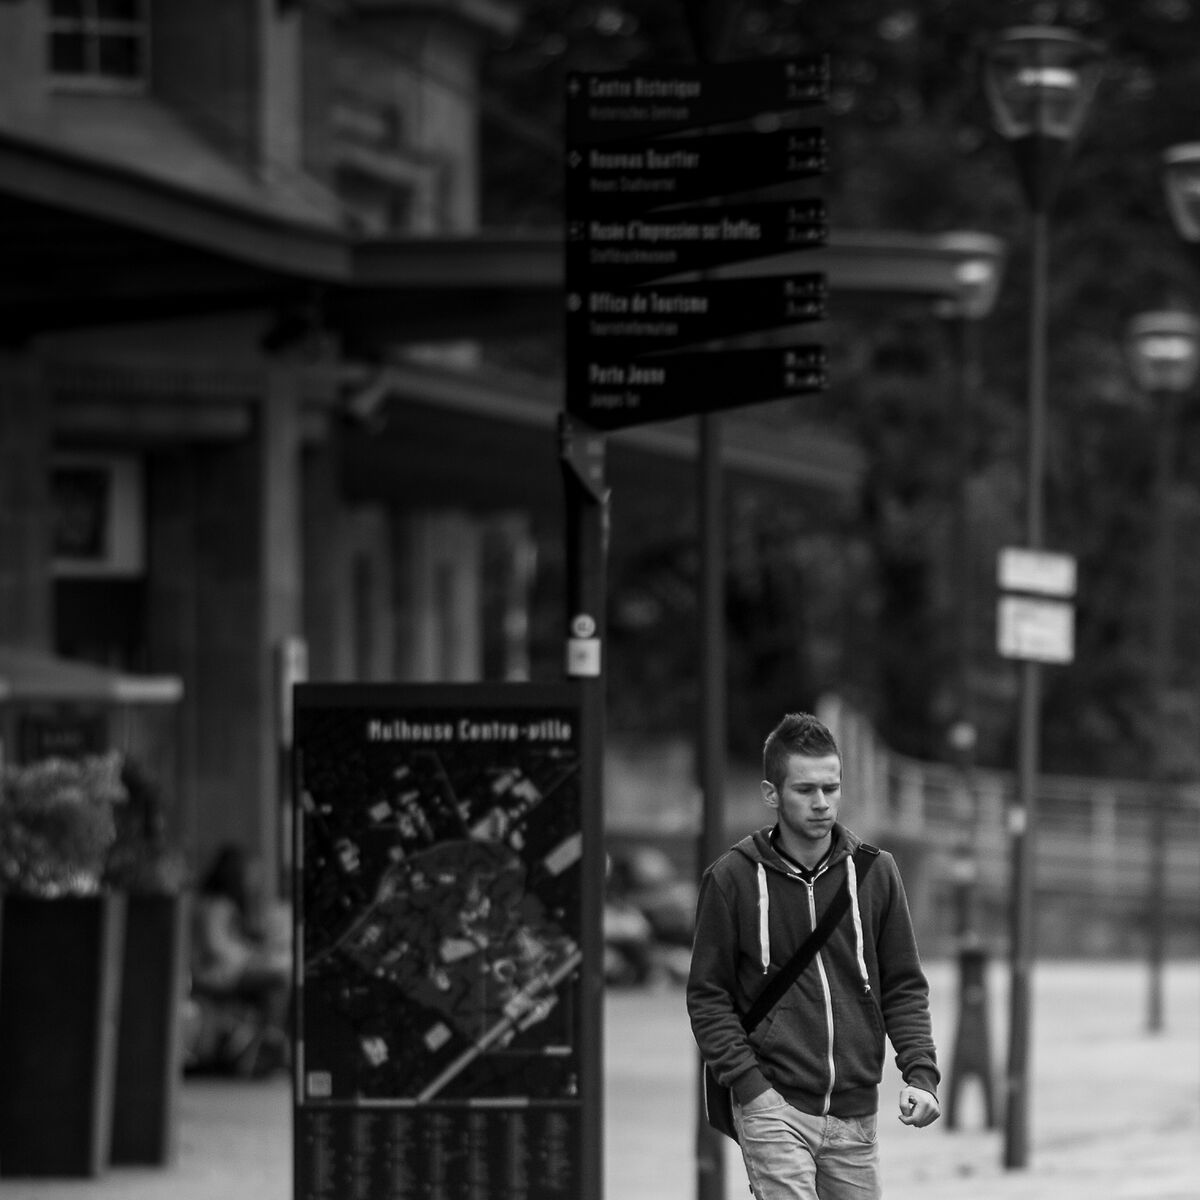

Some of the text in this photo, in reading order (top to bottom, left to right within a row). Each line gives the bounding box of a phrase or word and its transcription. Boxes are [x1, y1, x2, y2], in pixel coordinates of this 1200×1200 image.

[589, 292, 708, 313] Office de Tourisme
[589, 363, 666, 385] Porte Jeune
[367, 718, 572, 741] Mulhouse Centre-ville
